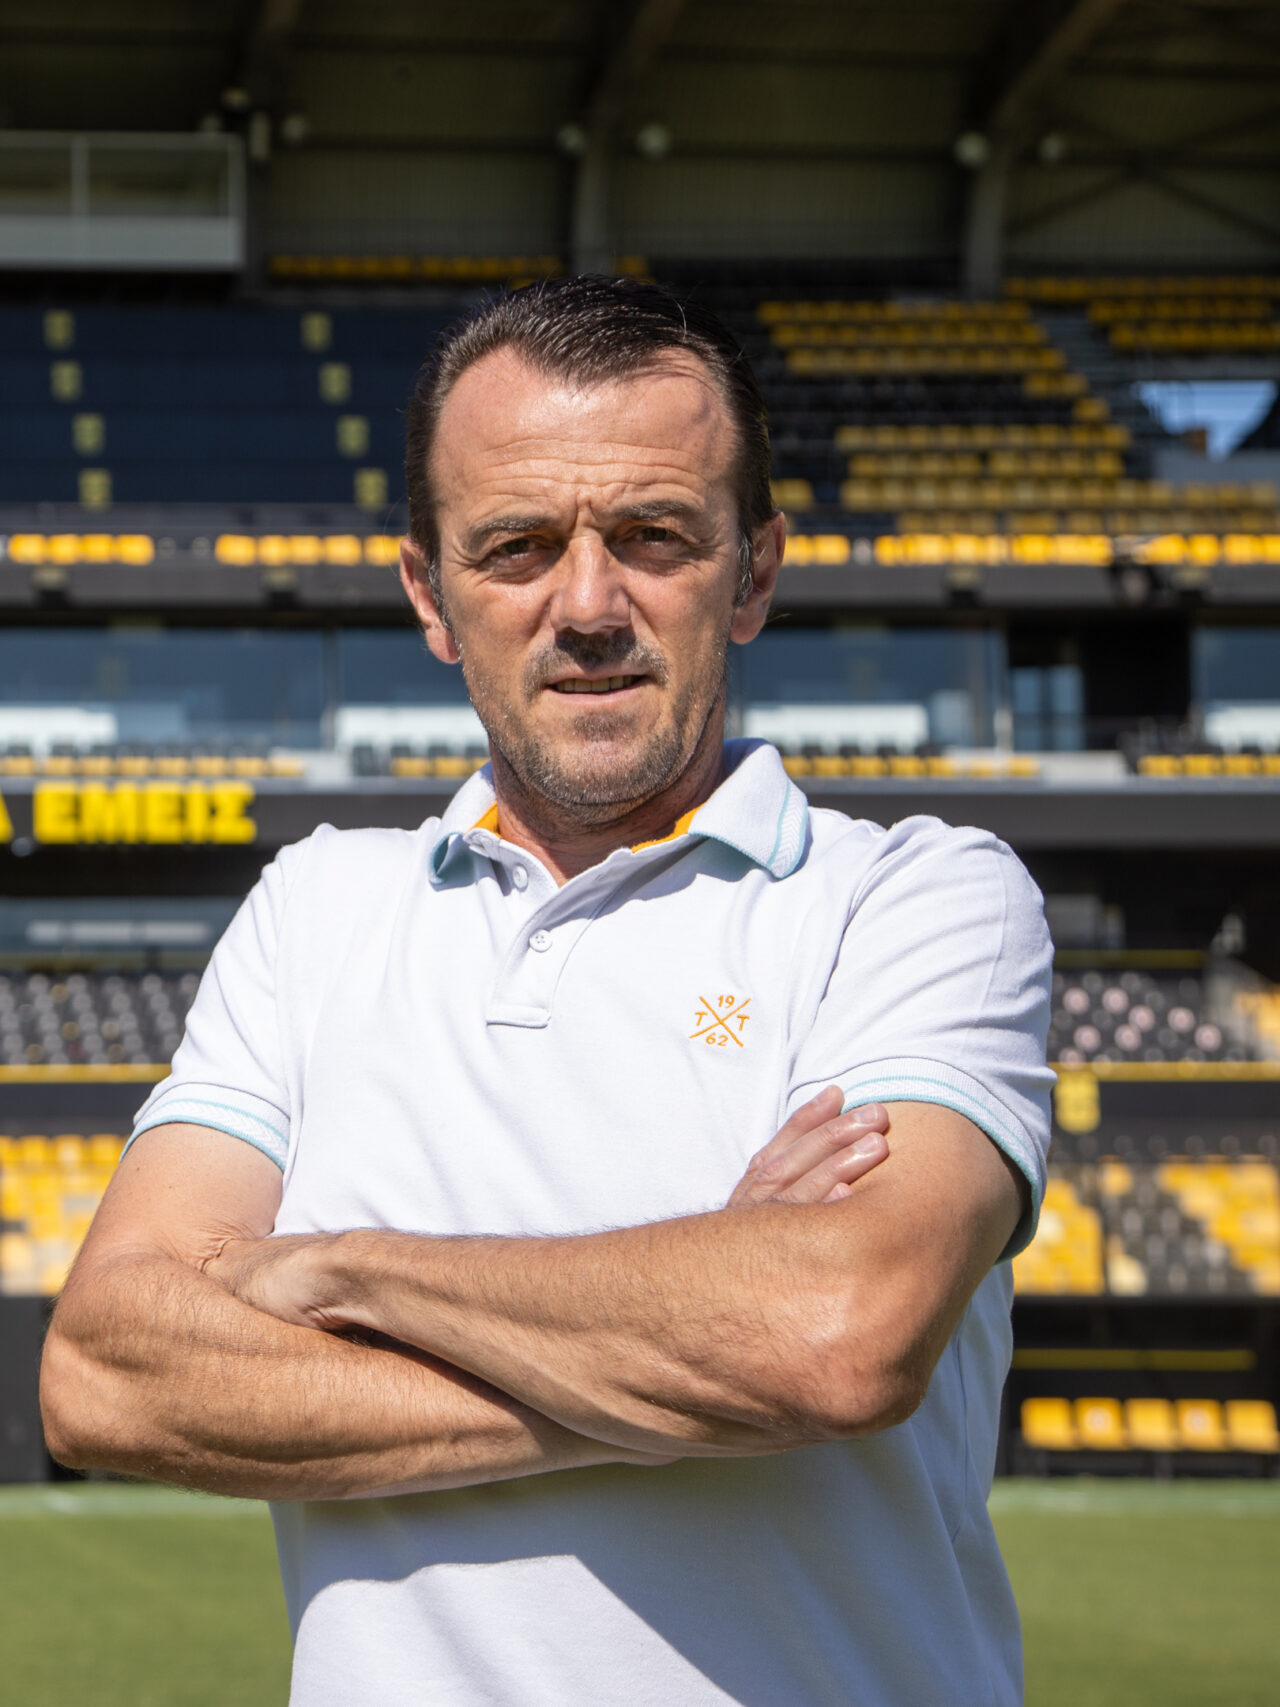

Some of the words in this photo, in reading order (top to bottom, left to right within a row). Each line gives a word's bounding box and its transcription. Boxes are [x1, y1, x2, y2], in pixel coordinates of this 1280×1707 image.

[33, 780, 257, 844] ΕΜΕΙΣ
[717, 994, 735, 1009] 19
[694, 1011, 708, 1027] T
[736, 1014, 750, 1031] T
[705, 1032, 729, 1047] 62
